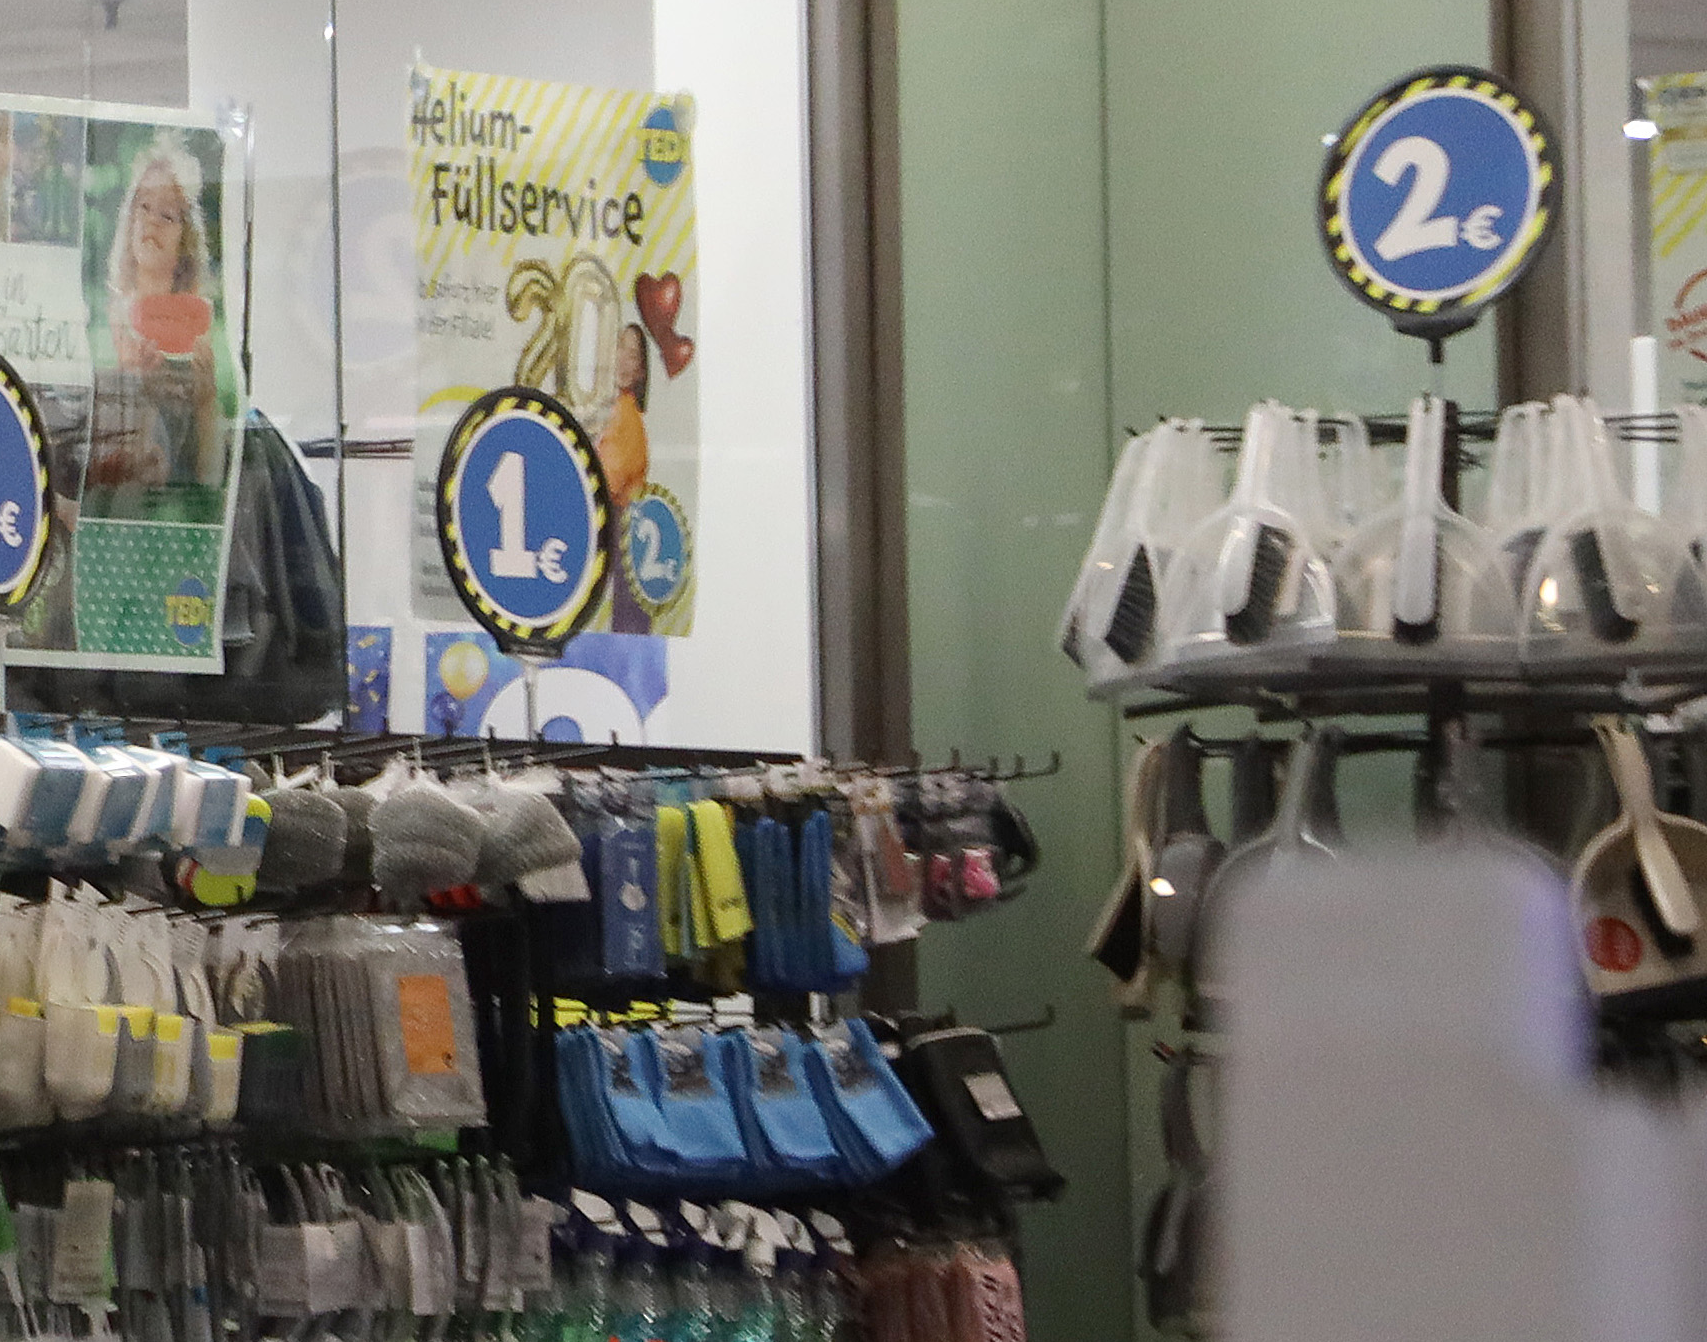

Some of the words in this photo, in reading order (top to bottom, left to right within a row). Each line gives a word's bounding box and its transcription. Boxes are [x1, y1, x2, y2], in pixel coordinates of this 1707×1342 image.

[432, 155, 645, 247] Füllservice
[1371, 135, 1503, 261] 2€
[486, 450, 569, 584] 1€
